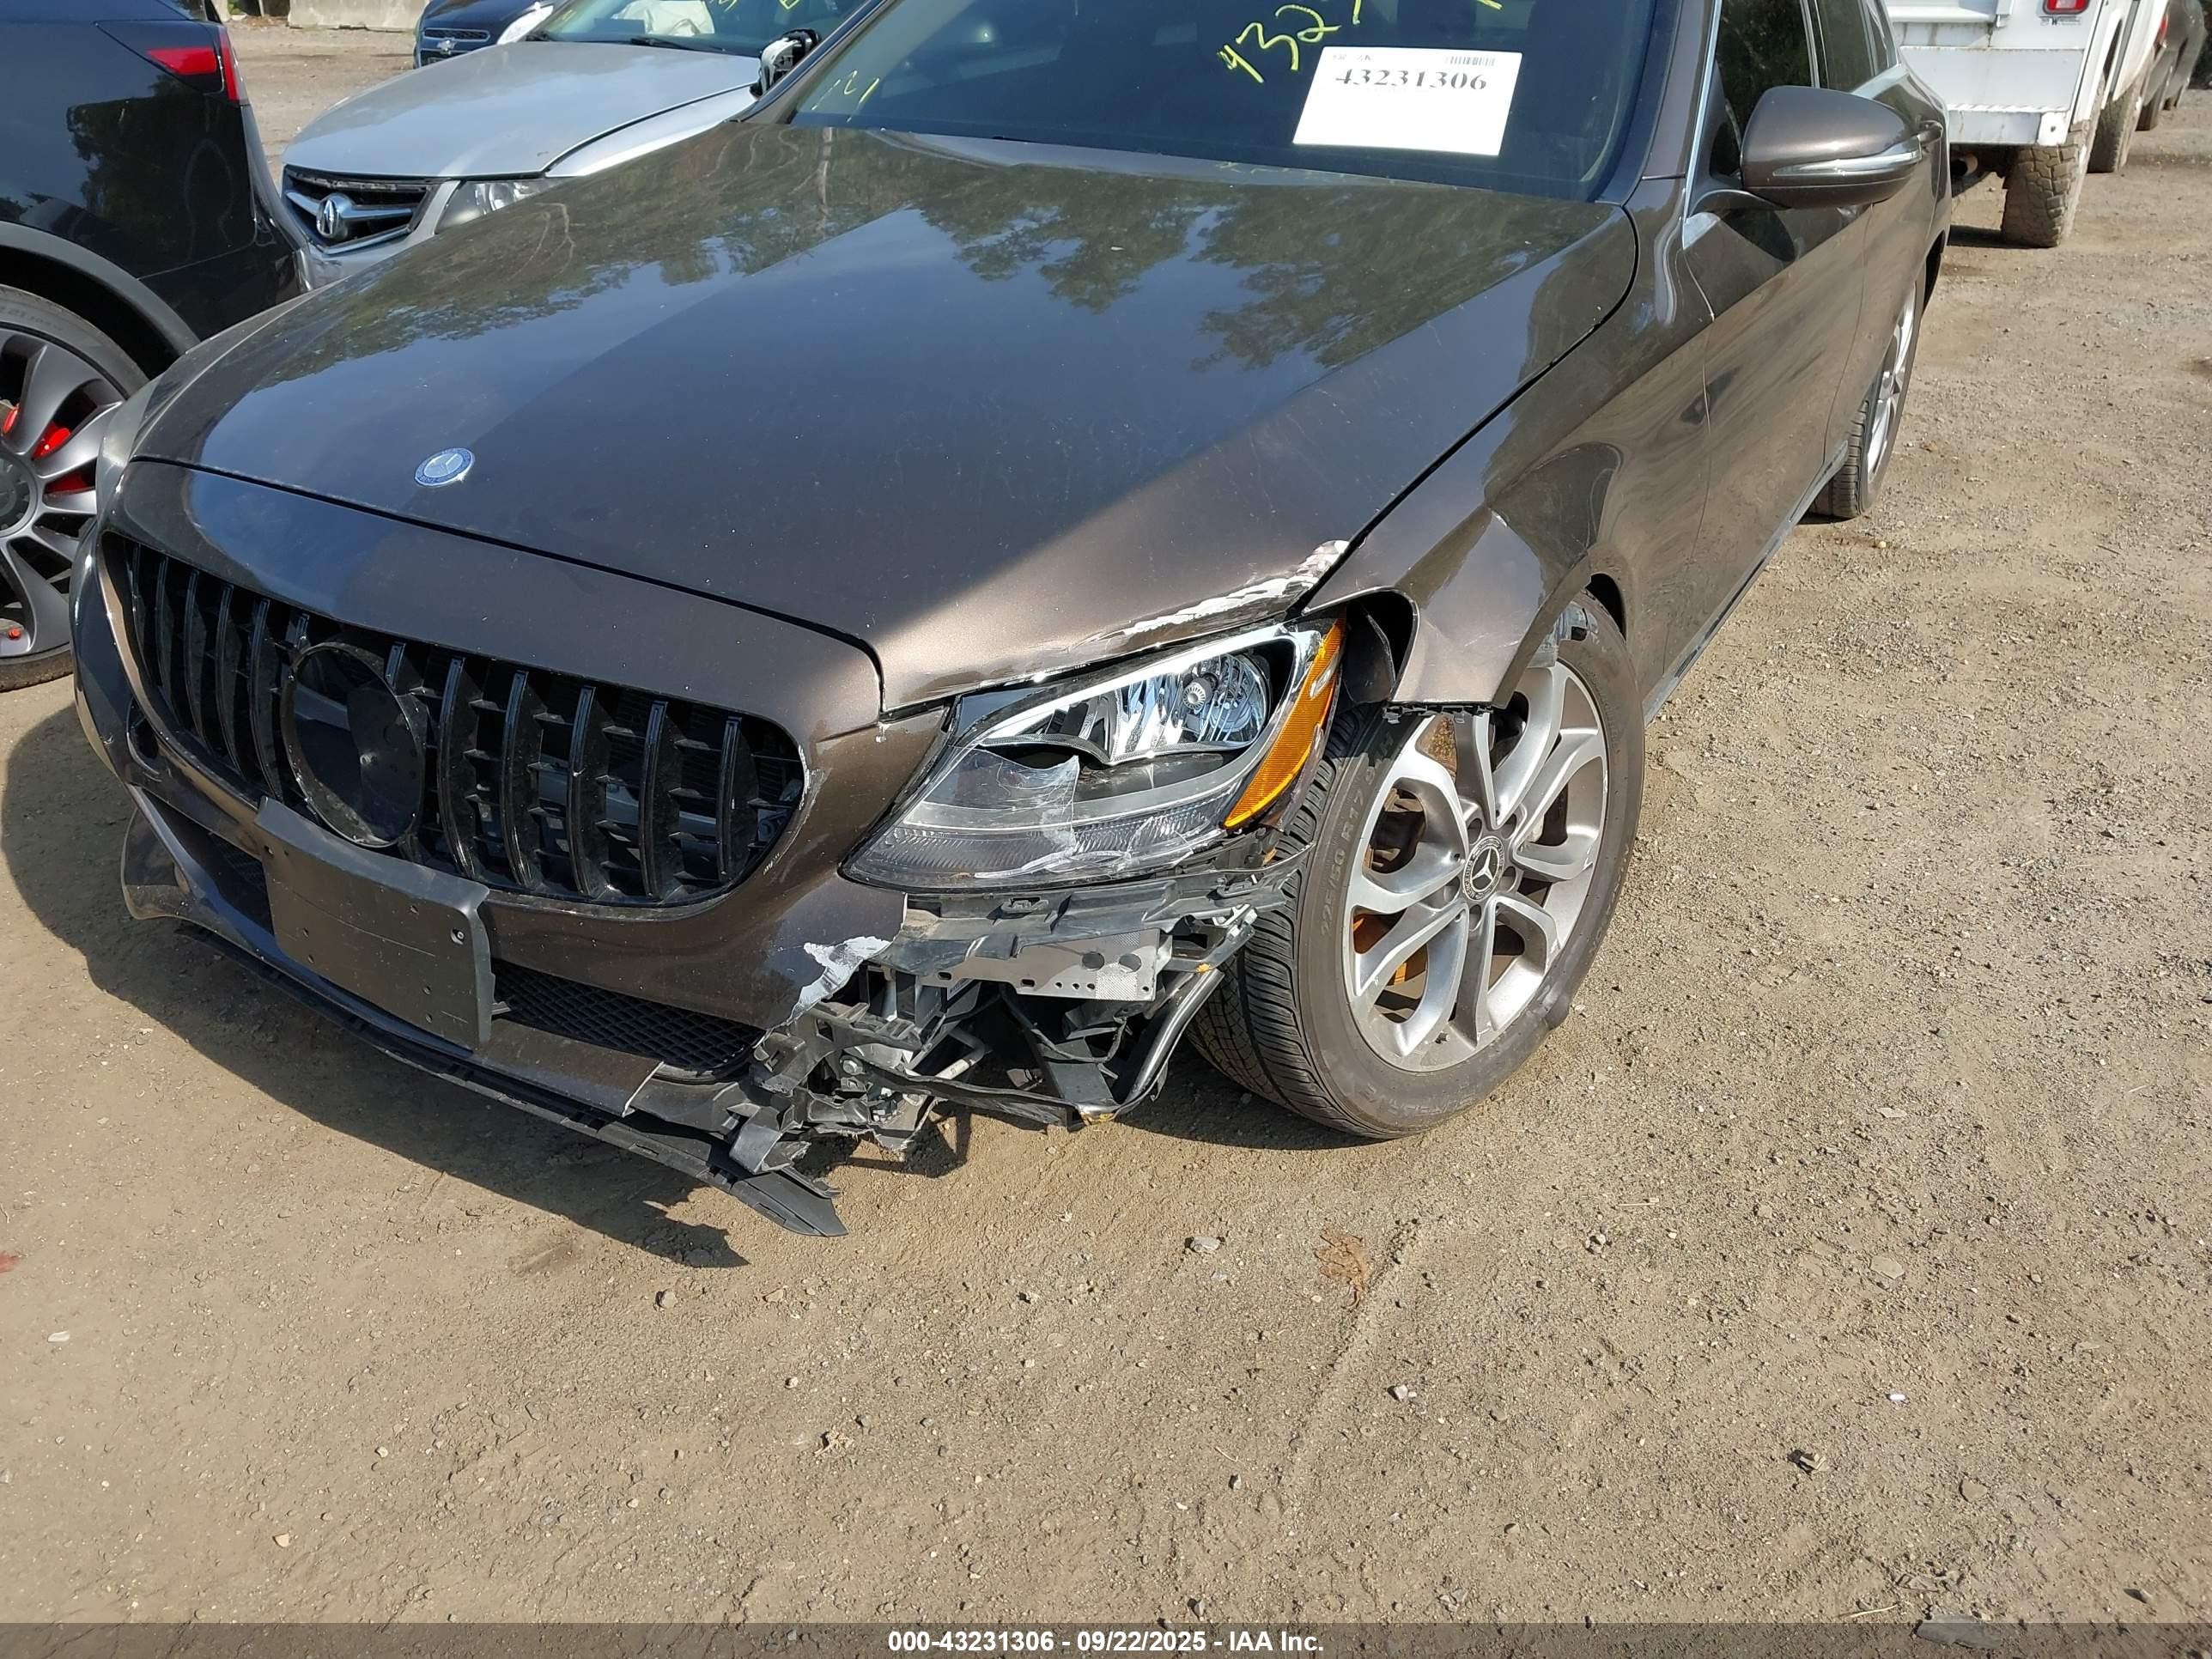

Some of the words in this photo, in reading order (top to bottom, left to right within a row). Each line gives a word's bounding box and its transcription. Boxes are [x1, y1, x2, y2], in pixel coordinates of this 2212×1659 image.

[1335, 68, 1487, 90] 43231306
[1320, 849, 1346, 937] 225/50
[1340, 788, 1364, 842] R17
